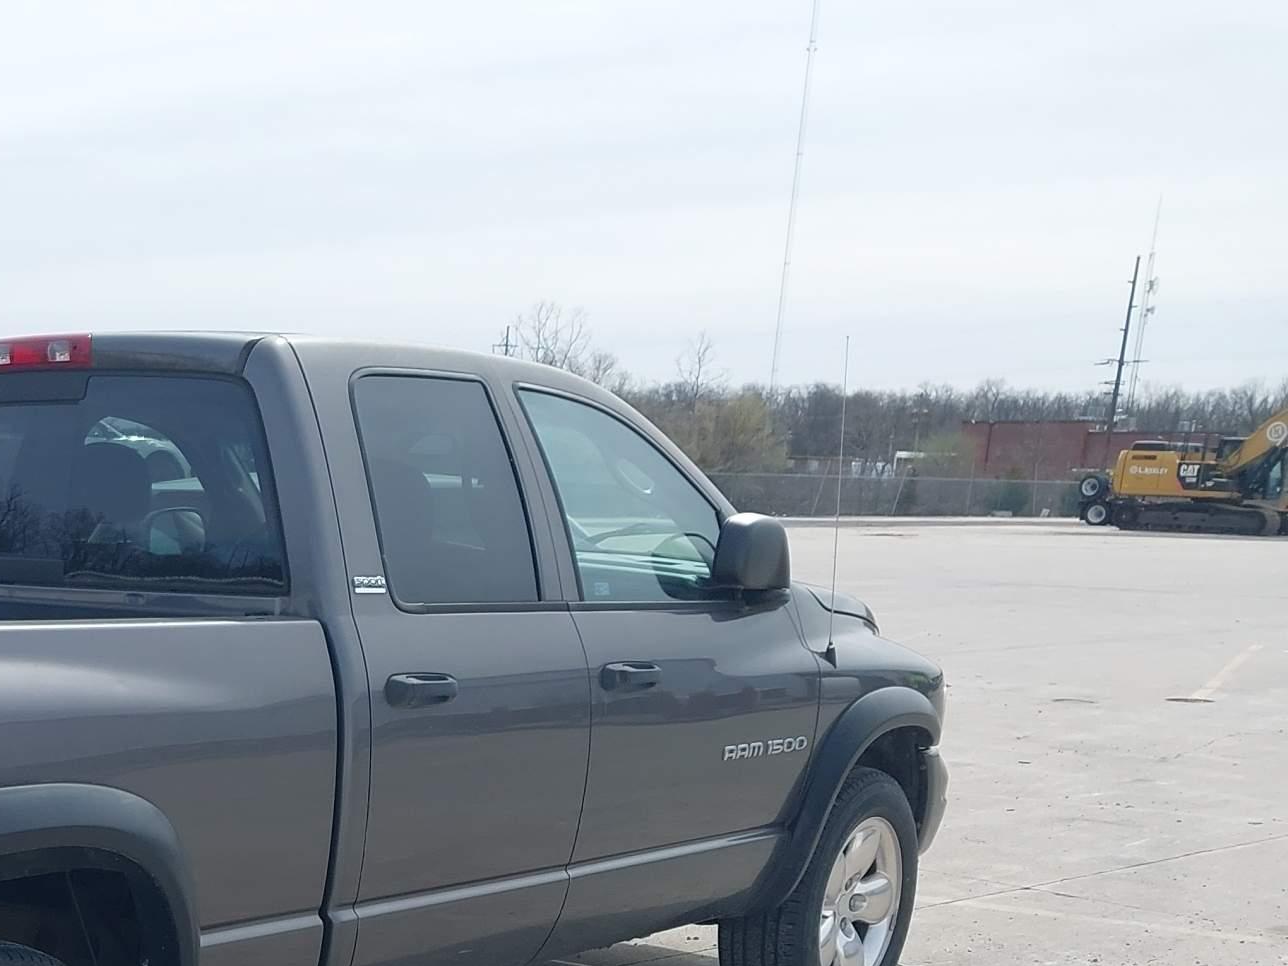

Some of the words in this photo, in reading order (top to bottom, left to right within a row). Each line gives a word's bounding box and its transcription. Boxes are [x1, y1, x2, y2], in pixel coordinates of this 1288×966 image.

[1179, 463, 1201, 477] CAT
[723, 742, 764, 761] RAM
[766, 736, 807, 755] 1500
